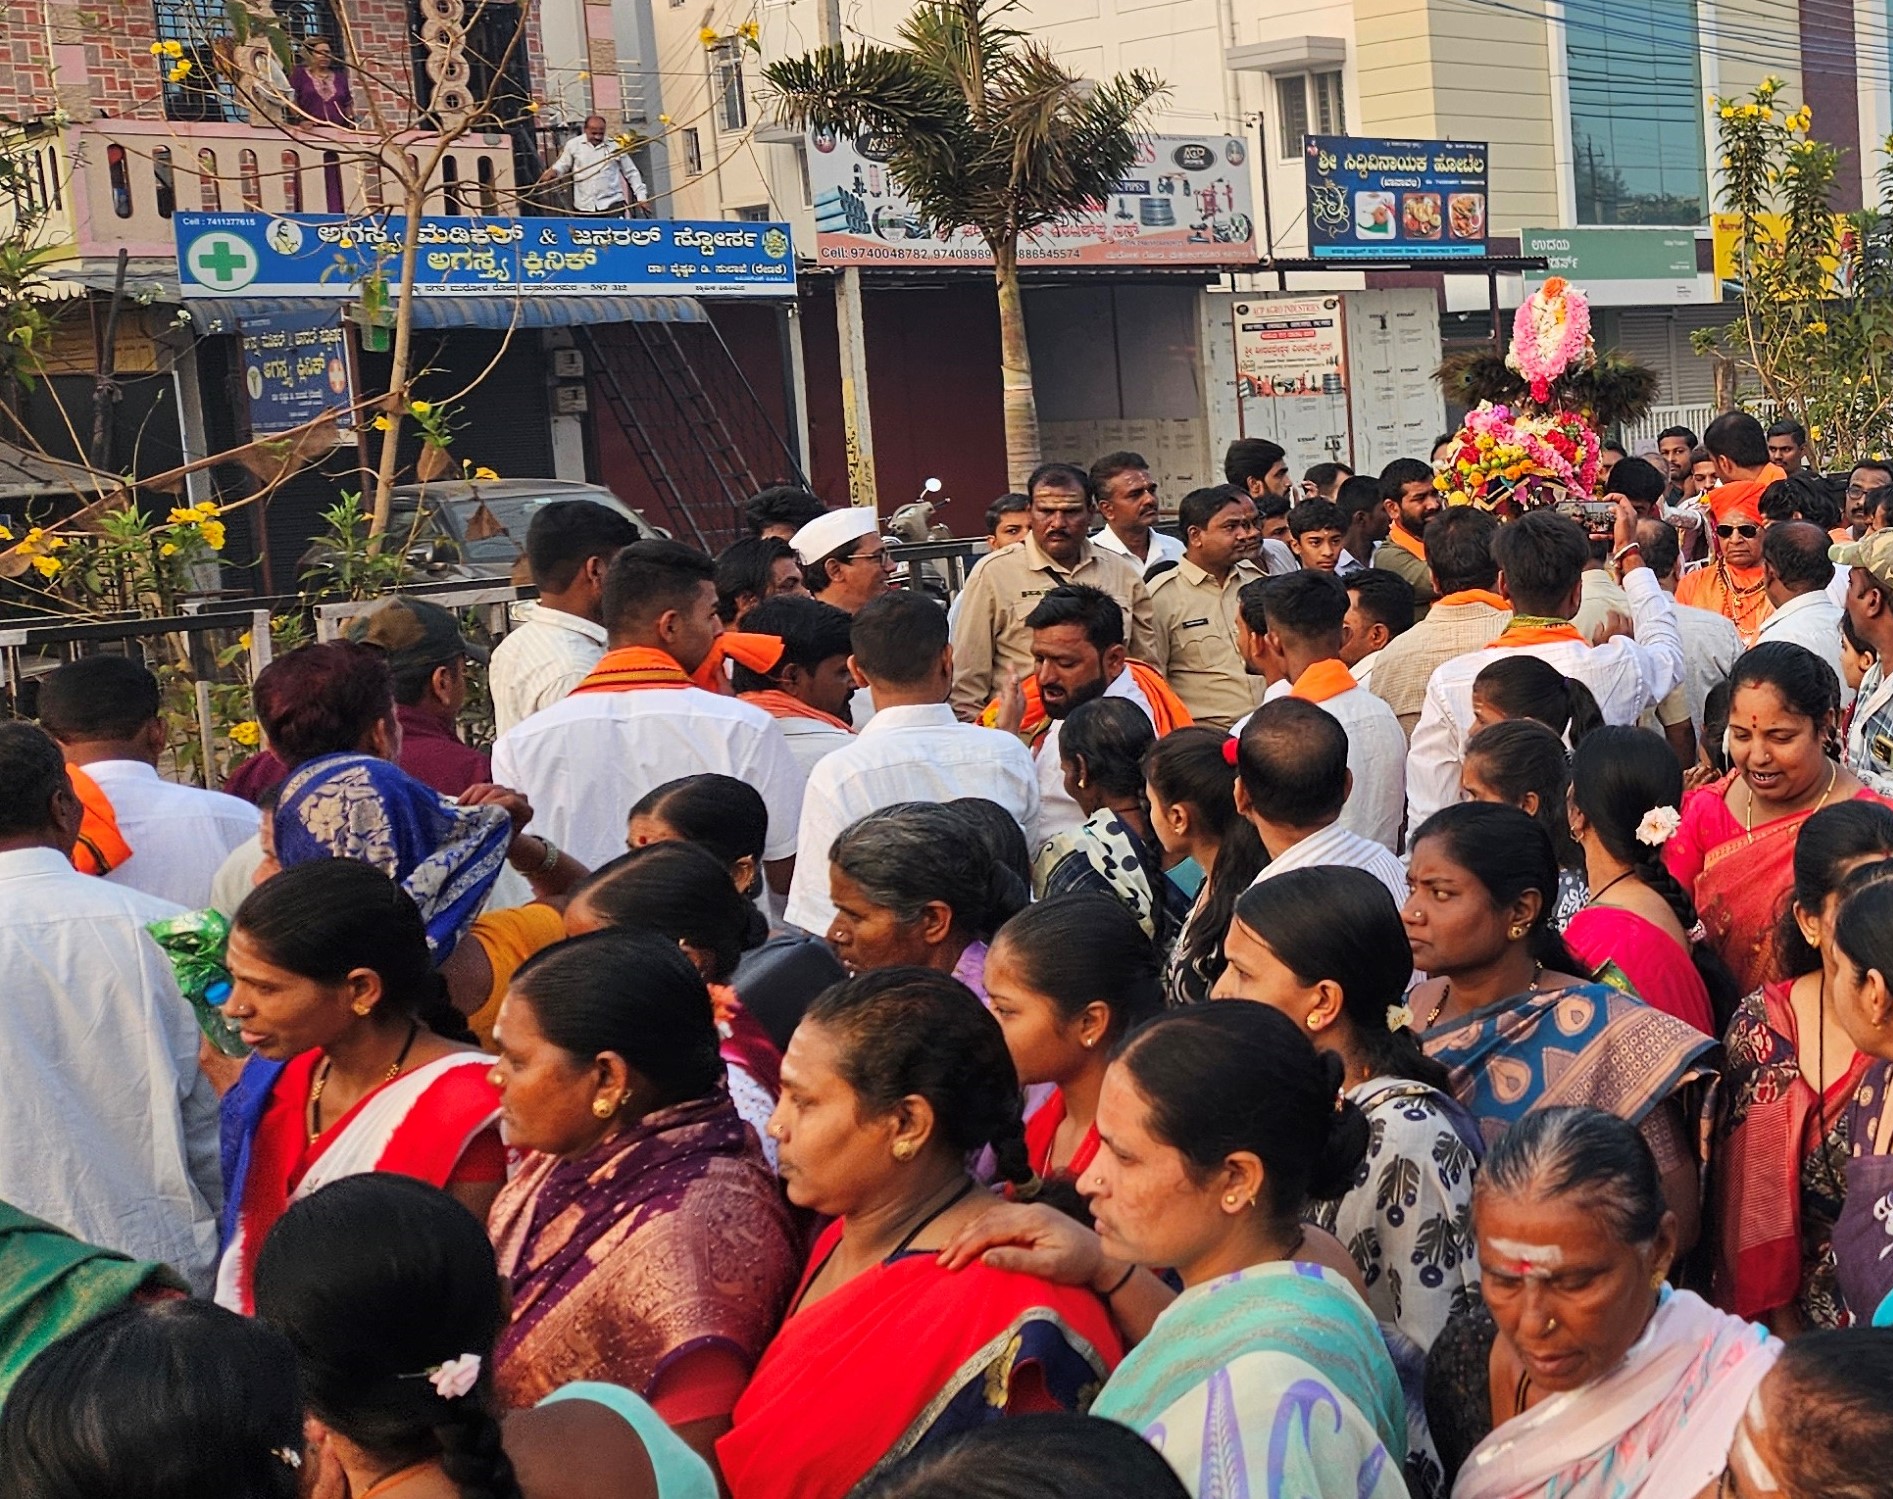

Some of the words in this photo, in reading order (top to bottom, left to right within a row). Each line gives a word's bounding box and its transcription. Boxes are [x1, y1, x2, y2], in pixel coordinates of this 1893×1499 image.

[1317, 150, 1337, 176] ಶ್ರೀ
[538, 228, 559, 246] &
[1531, 239, 1570, 251] ಉದಯ
[821, 247, 849, 258] Cell:
[521, 247, 599, 278] ಕ್ಲಿನಿಕ್
